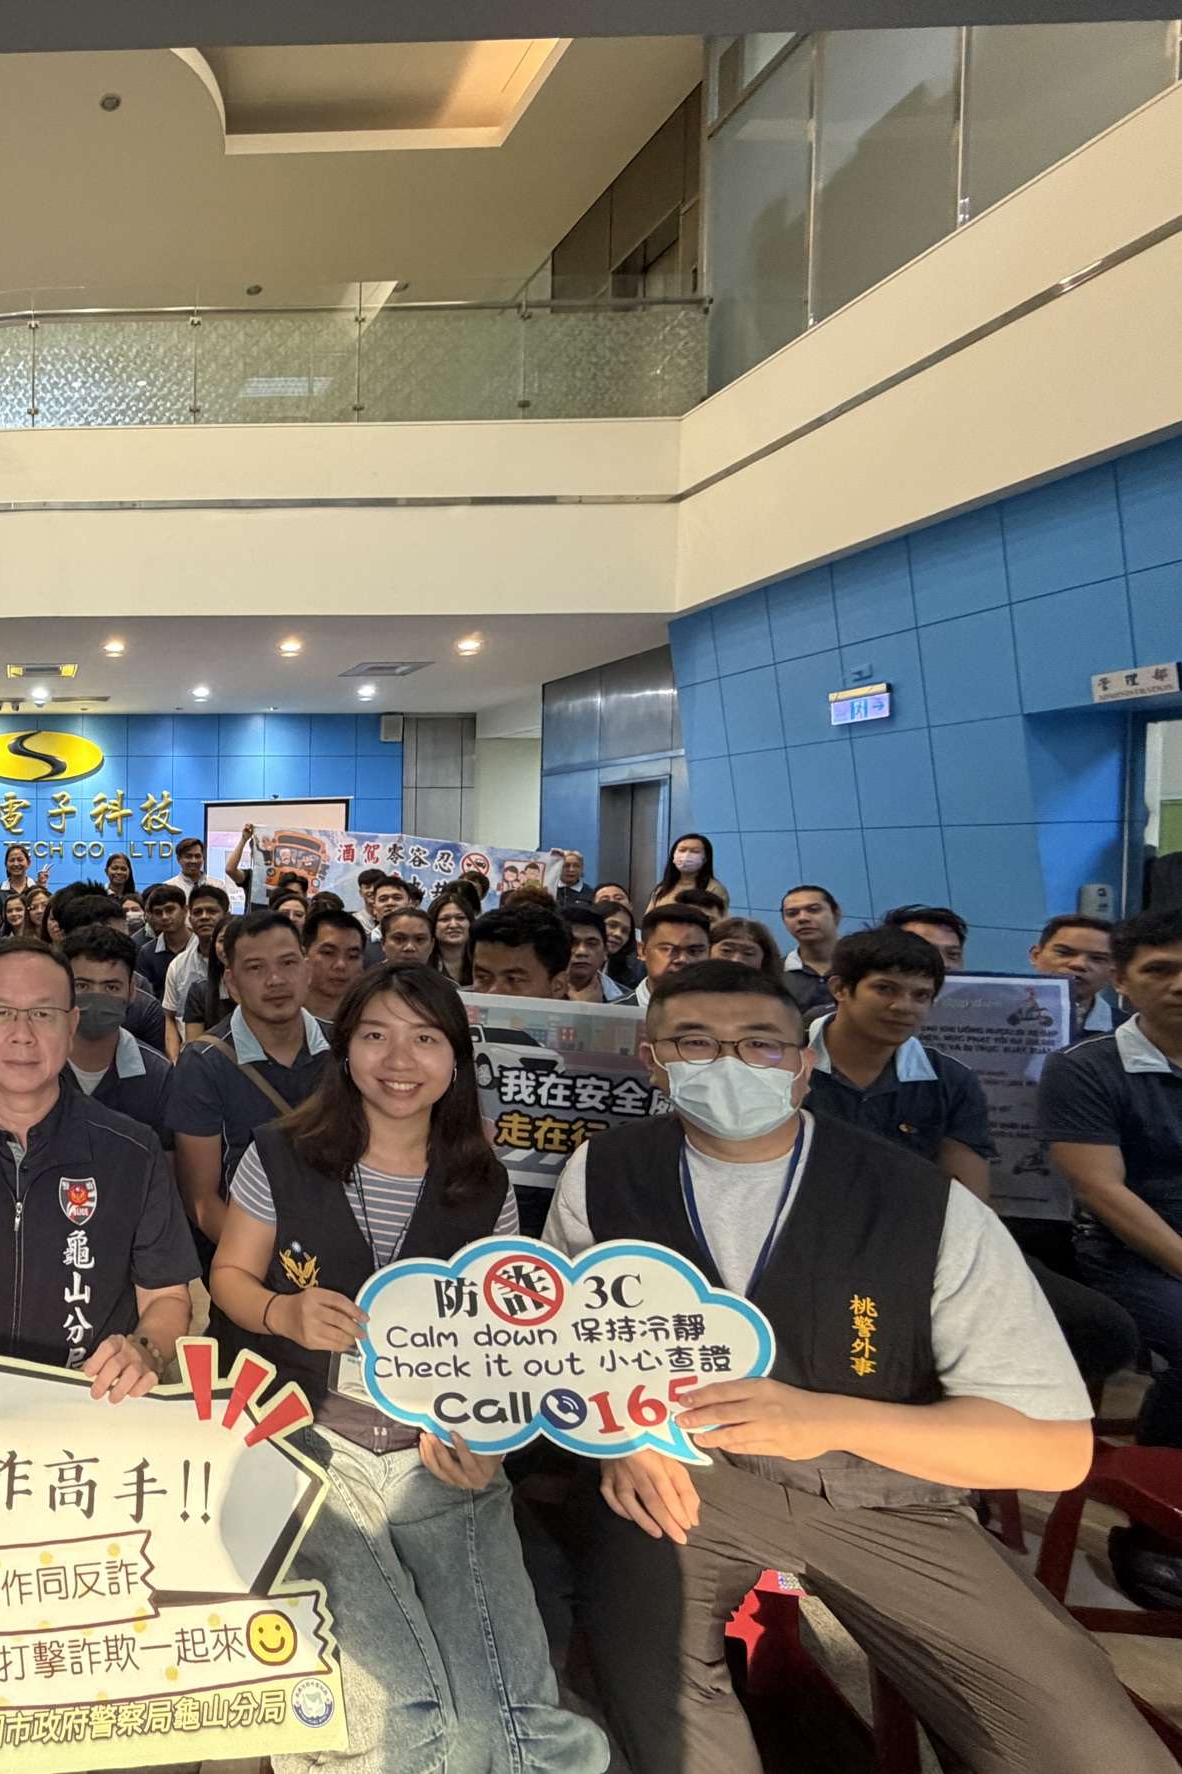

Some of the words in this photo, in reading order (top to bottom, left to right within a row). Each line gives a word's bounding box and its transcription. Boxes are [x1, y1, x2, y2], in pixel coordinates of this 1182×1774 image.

[337, 843, 455, 873] 酒駕零容忍
[583, 1273, 644, 1309] 3C
[386, 1325, 458, 1348] Calm
[474, 1324, 557, 1346] down
[571, 1314, 705, 1343] 保持冷靜
[849, 1294, 878, 1376] 桃警外事
[373, 1355, 471, 1378] Check
[485, 1353, 512, 1377] it
[524, 1352, 585, 1376] out
[600, 1345, 731, 1373] 小心查證
[433, 1391, 533, 1424] Call
